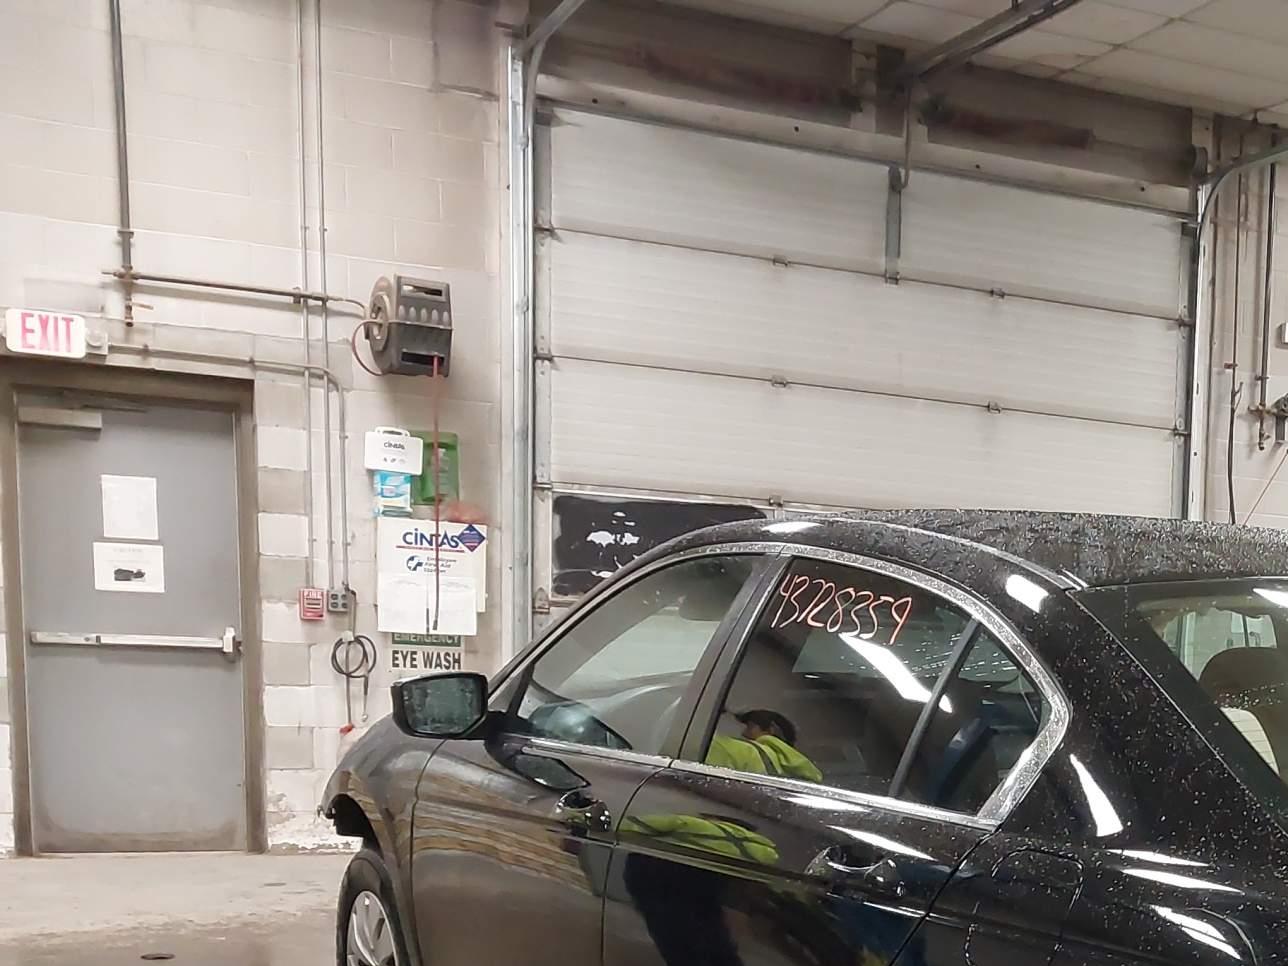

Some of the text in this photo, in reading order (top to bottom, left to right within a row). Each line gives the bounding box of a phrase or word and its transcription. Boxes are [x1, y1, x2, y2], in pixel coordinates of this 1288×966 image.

[21, 312, 75, 353] EXIT
[771, 573, 912, 645] 43728359
[392, 650, 461, 670] EYE WASH
